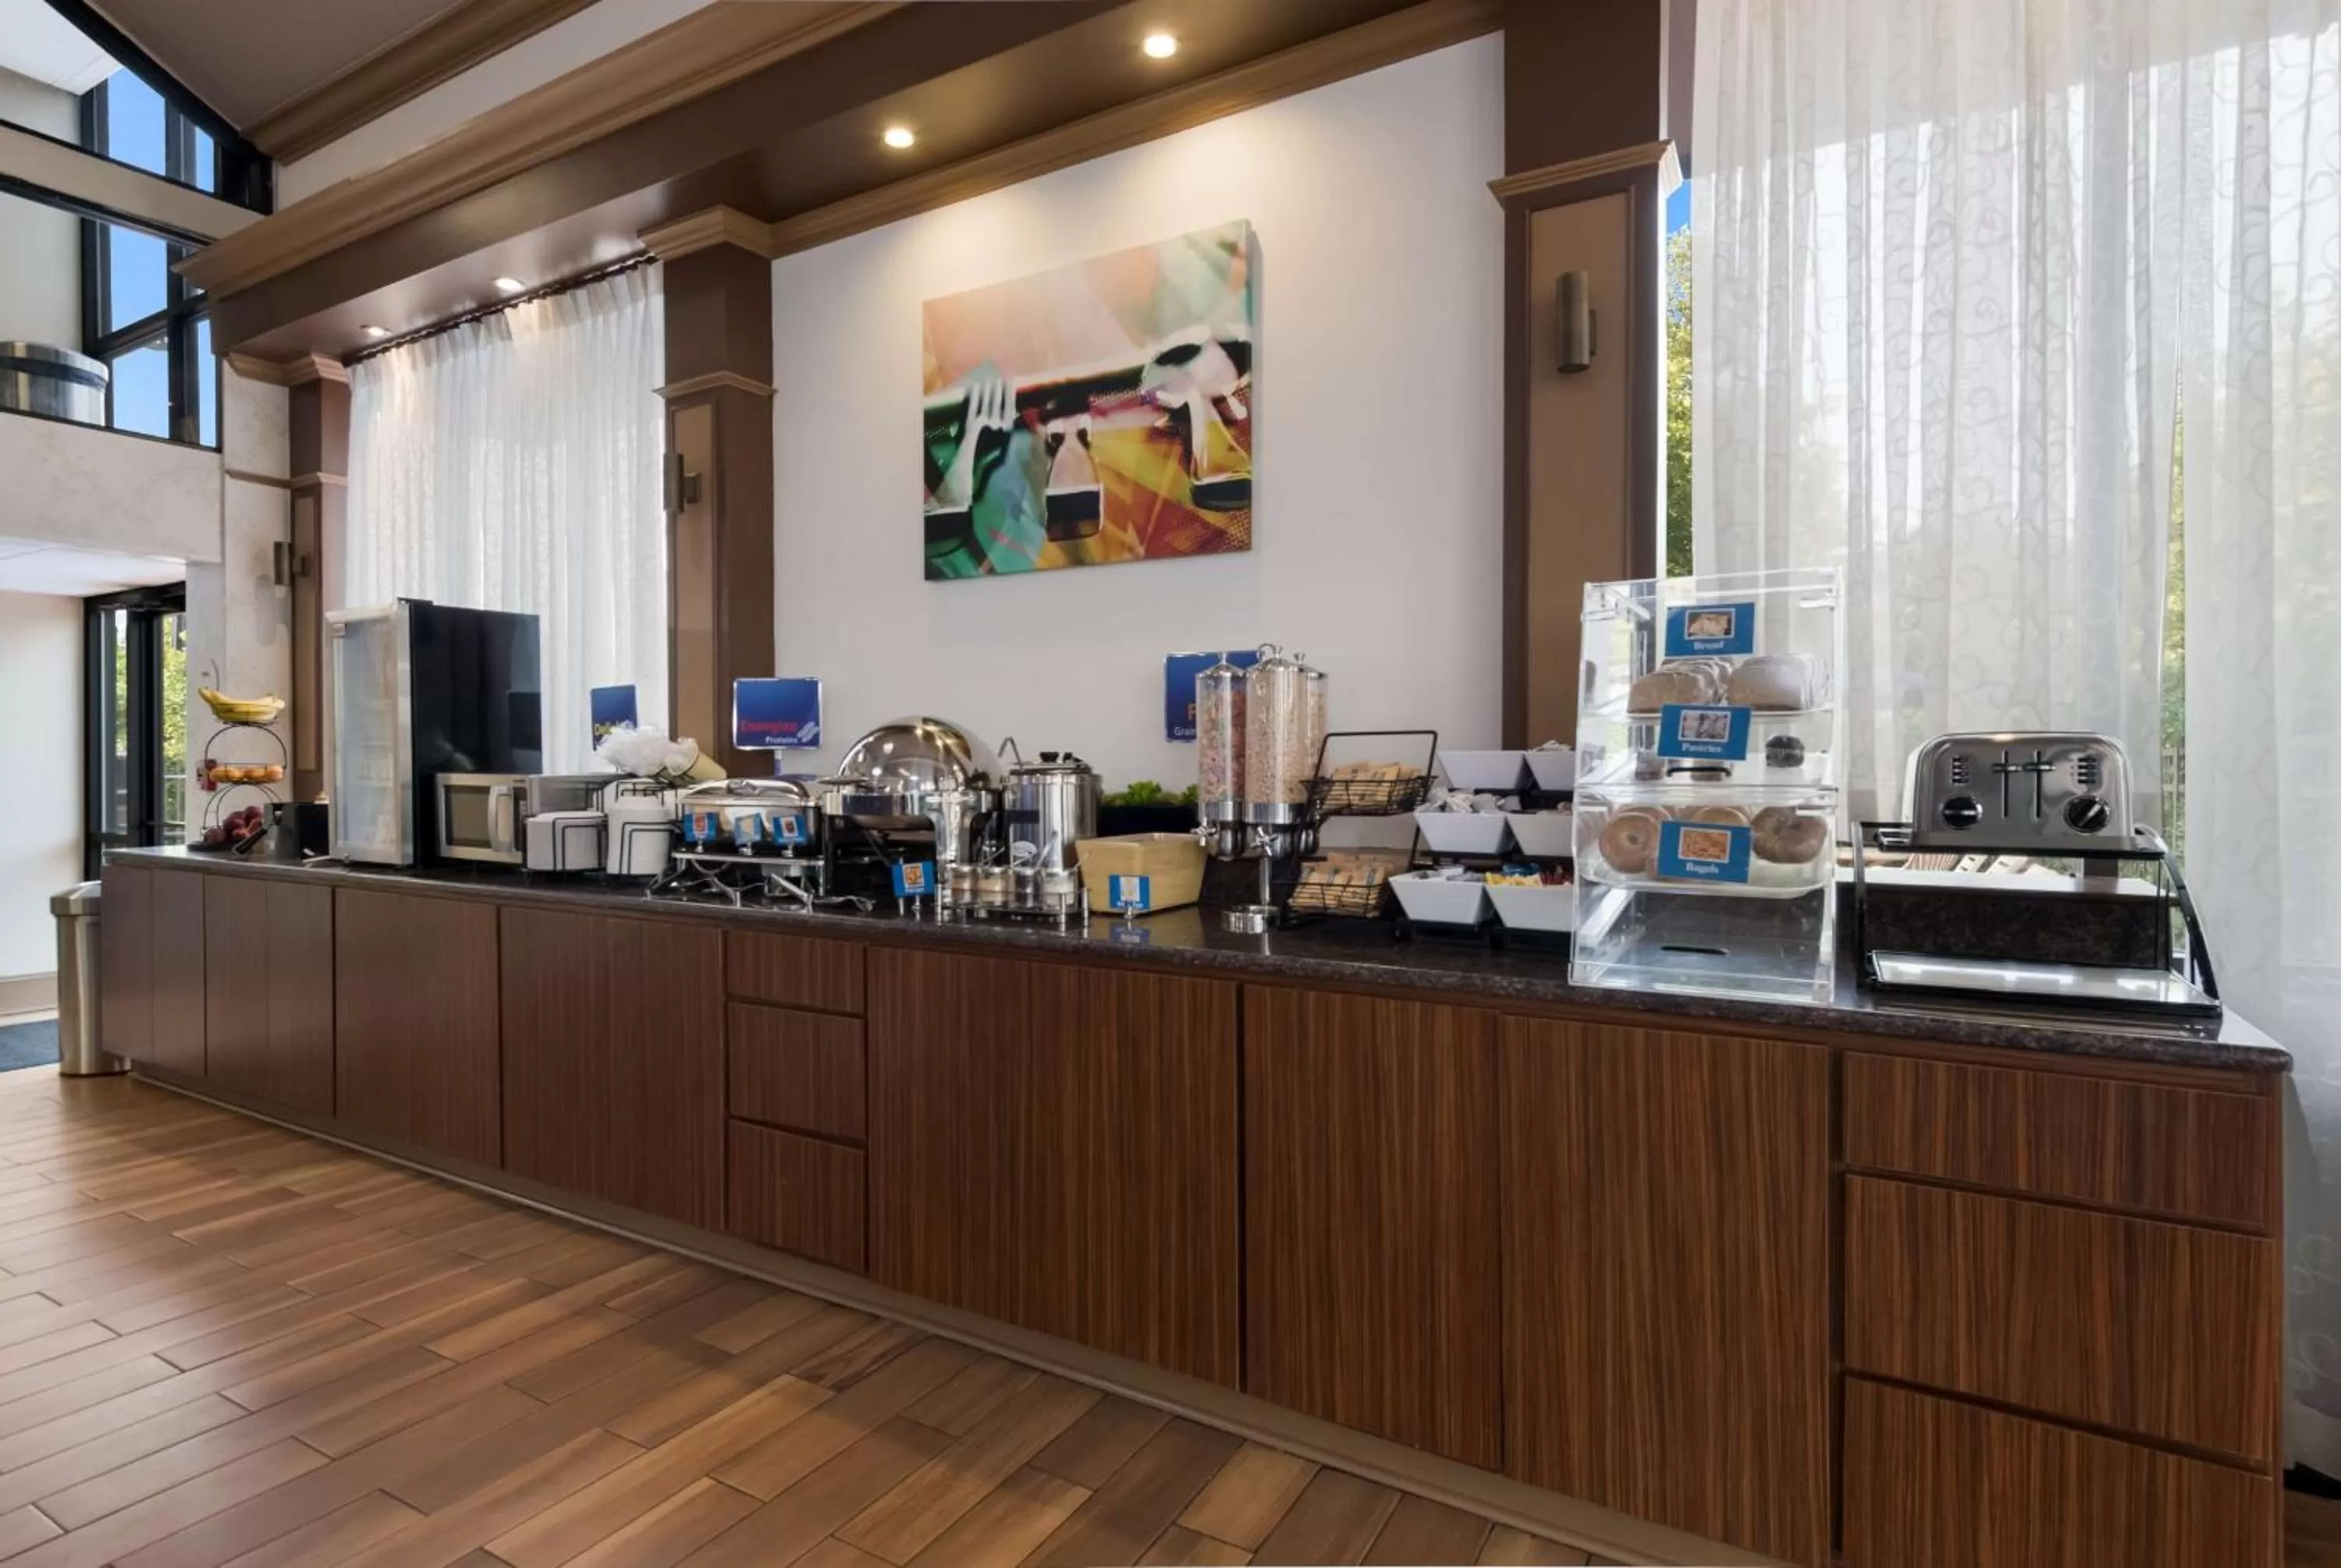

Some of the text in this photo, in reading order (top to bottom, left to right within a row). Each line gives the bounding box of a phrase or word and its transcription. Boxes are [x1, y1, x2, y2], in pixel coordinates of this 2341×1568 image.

[1693, 640, 1724, 650] Bread
[1682, 743, 1722, 753] Pastries
[1686, 861, 1720, 874] Bagels
